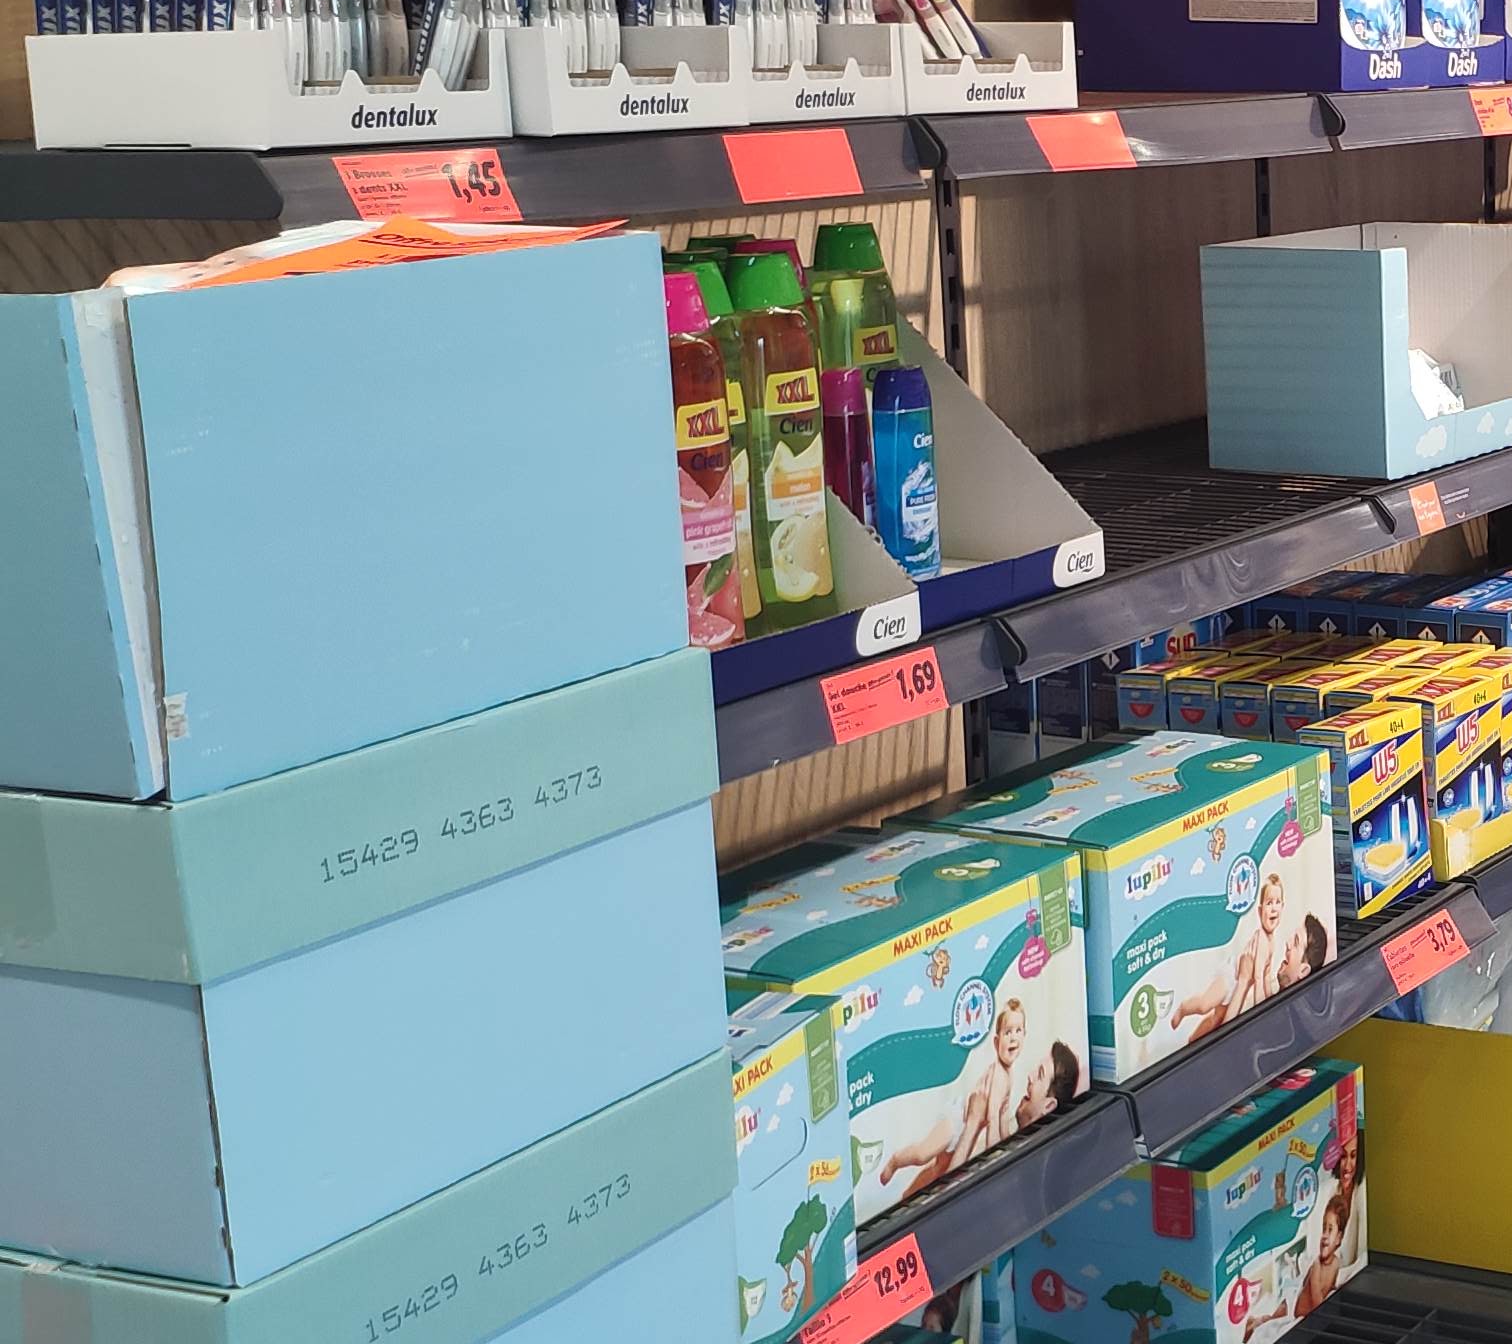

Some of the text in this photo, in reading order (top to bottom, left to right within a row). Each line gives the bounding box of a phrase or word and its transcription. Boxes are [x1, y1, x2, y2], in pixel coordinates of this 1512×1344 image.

[1369, 53, 1402, 81] Dash
[1447, 51, 1478, 77] Dash
[619, 92, 690, 118] dentalux
[795, 86, 856, 110] dentalux
[966, 81, 1027, 104] dentalux
[351, 102, 438, 130] dentalux
[441, 159, 502, 204] 1,45
[862, 330, 895, 356] XXL
[775, 375, 815, 404] XXL
[686, 406, 724, 438] XXL
[780, 414, 813, 435] Cien
[690, 451, 724, 472] Cien
[1066, 547, 1096, 576] Cien
[873, 611, 908, 642] Cien
[896, 659, 935, 703] 1,69
[1473, 689, 1487, 705] 40+4
[1389, 718, 1404, 734] 40+4
[1455, 709, 1480, 756] W5
[1371, 737, 1399, 787] W5
[320, 764, 605, 885] 15429 4363 4373
[1182, 800, 1230, 833] MAXI PACK
[1125, 859, 1172, 895] lupilu
[892, 917, 954, 958] MAXI PACK
[1126, 930, 1169, 960] maxi pack
[1426, 917, 1457, 953] 3,79
[1127, 957, 1144, 974] soft
[1153, 947, 1167, 966] dry
[842, 988, 880, 1026] pilu
[1137, 992, 1150, 1020] 3
[747, 1057, 774, 1087] PACK
[849, 1071, 875, 1097] pack
[855, 1089, 873, 1108] dry
[1225, 1170, 1262, 1205] lupilu
[476, 1221, 550, 1276] 4363
[565, 1172, 634, 1228] 4373
[873, 1250, 919, 1298] 12,99
[1041, 1274, 1055, 1298] 4
[1162, 1270, 1171, 1283] 2
[1178, 1277, 1193, 1294] 50
[1233, 1282, 1243, 1307] 4
